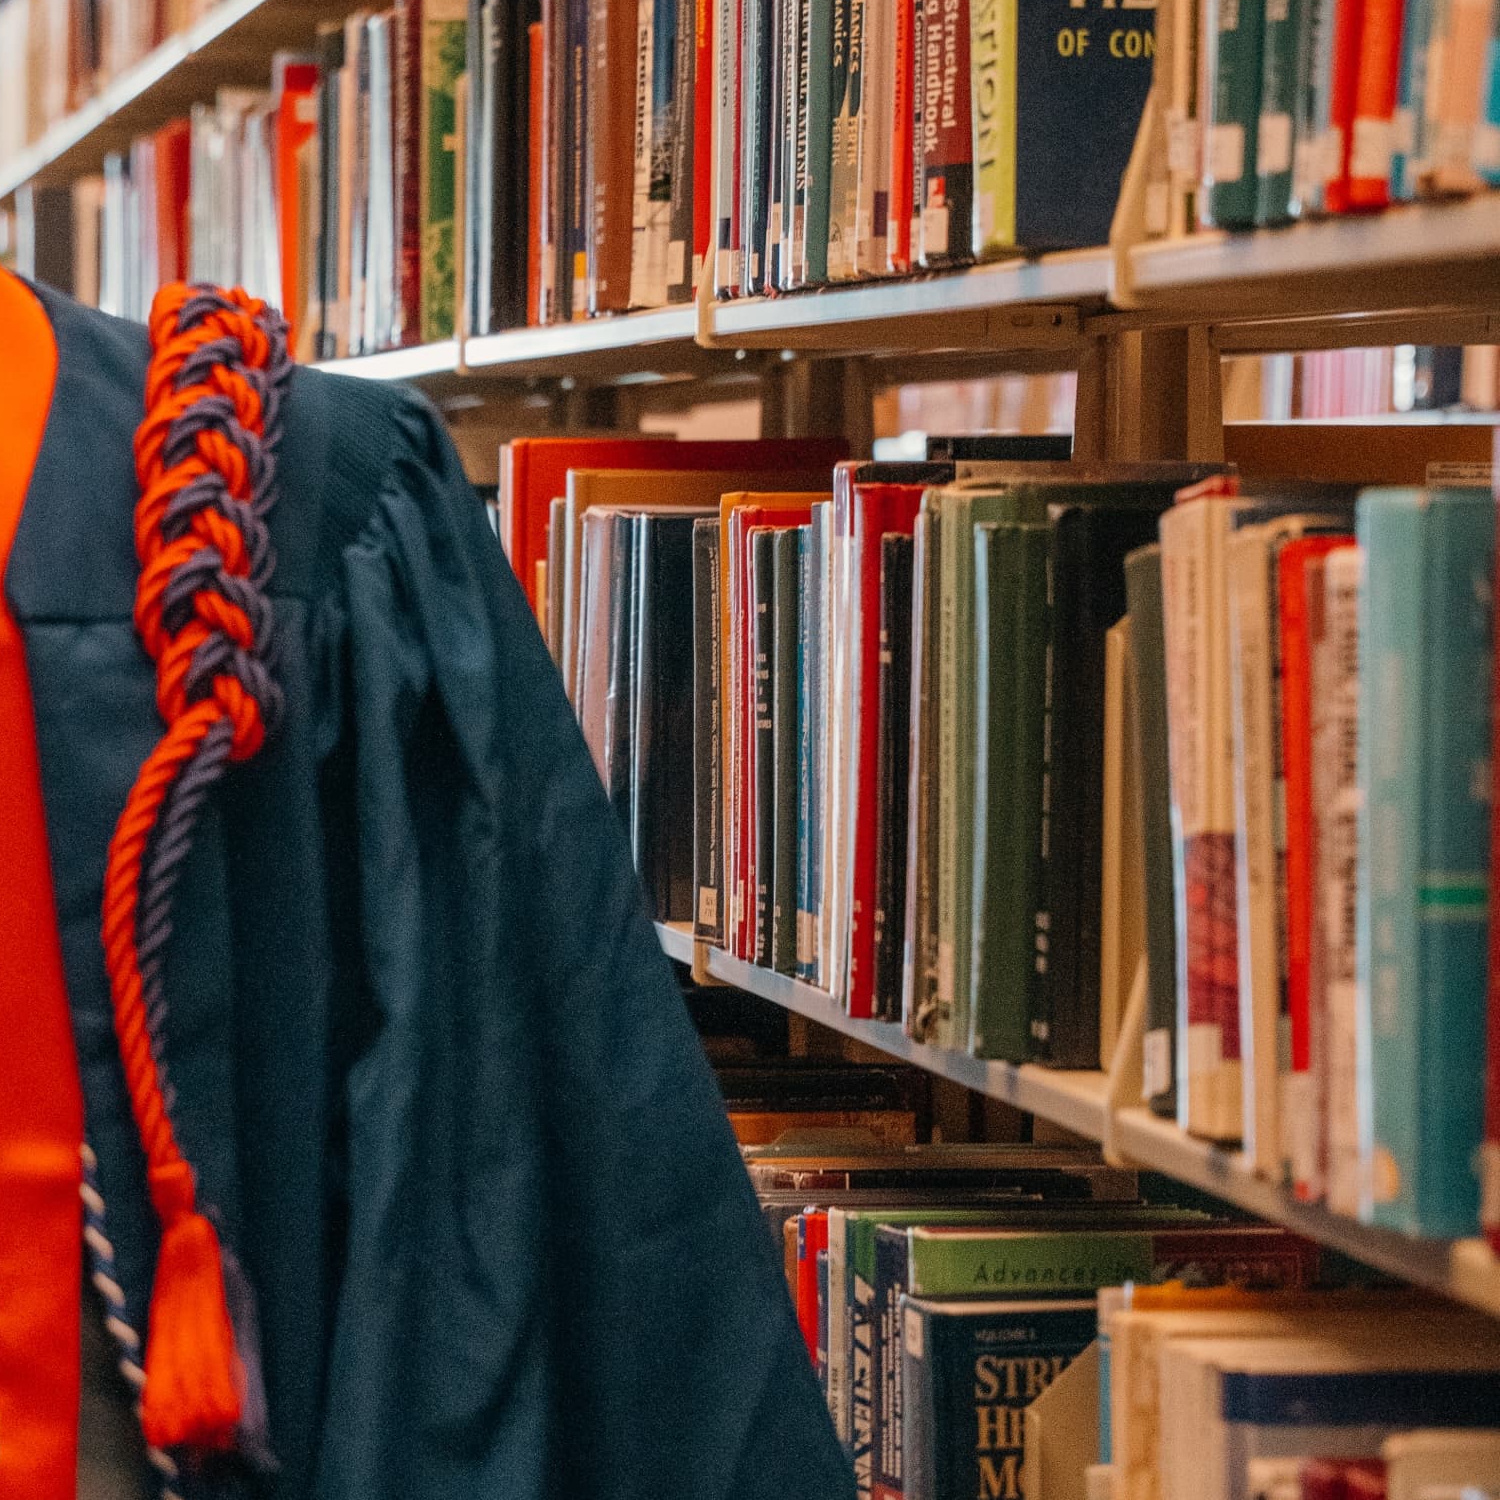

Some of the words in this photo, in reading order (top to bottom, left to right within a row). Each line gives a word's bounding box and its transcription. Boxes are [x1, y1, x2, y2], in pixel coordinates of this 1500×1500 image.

[913, 10, 926, 115] Construction
[1056, 27, 1092, 58] OF
[636, 28, 650, 161] Structures
[924, 22, 944, 155] Handbook
[912, 121, 924, 206] Inspection
[973, 1261, 1098, 1286] Advances
[978, 1457, 1026, 1500] M
